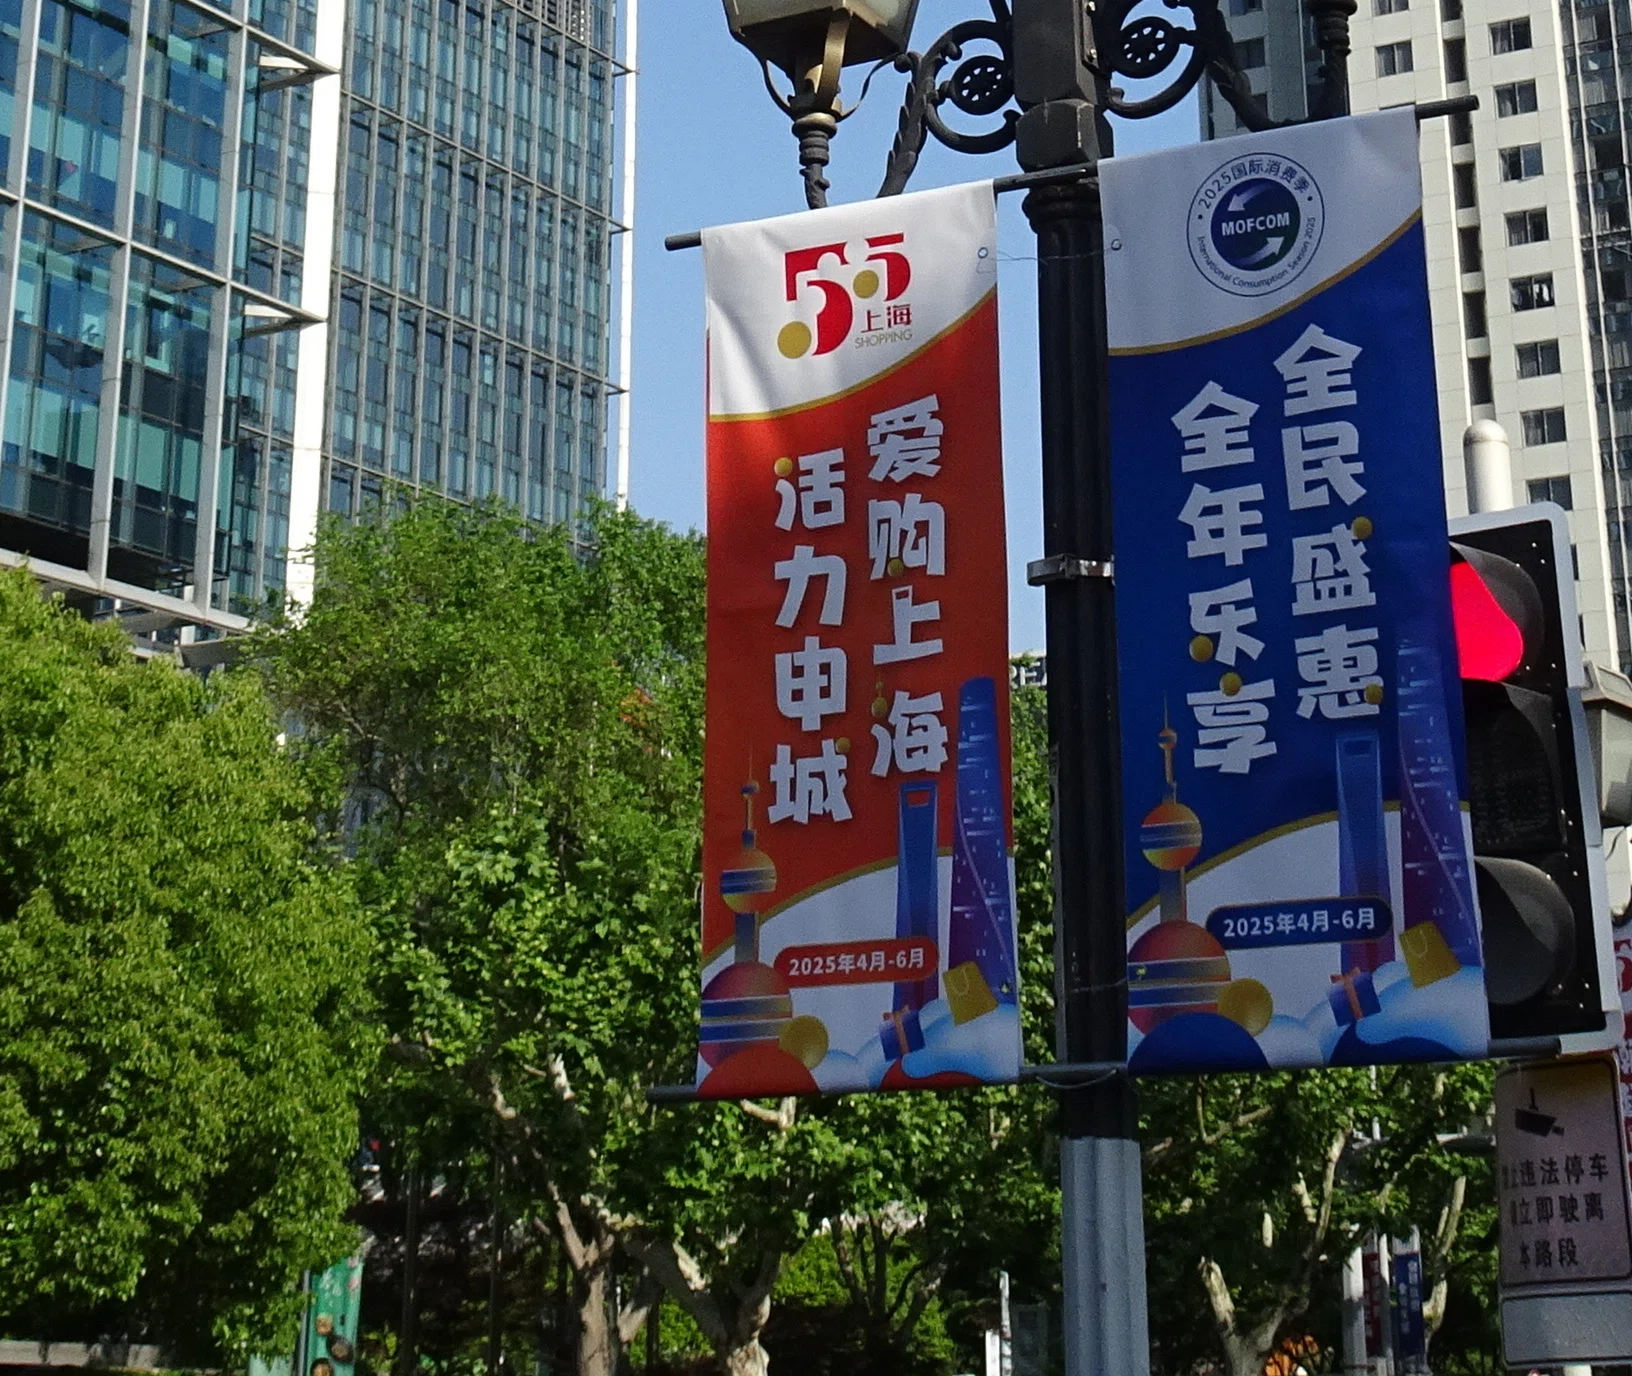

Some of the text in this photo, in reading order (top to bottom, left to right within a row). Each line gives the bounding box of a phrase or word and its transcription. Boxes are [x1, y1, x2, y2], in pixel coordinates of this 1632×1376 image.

[1198, 159, 1310, 209] 2025国际消费季
[1221, 212, 1290, 236] MOFCOM
[1197, 216, 1316, 289] International Consumption Season 2025
[855, 329, 913, 349] SHOPPING
[861, 304, 912, 333] 上海
[1273, 323, 1384, 719] 全民盛惠
[867, 394, 948, 778] 爱购上海
[1171, 380, 1277, 774] 全年乐享
[768, 447, 853, 825] 活力申城
[1223, 907, 1375, 938] 2025年4月-6月
[788, 947, 925, 976] 2025年4月-6月
